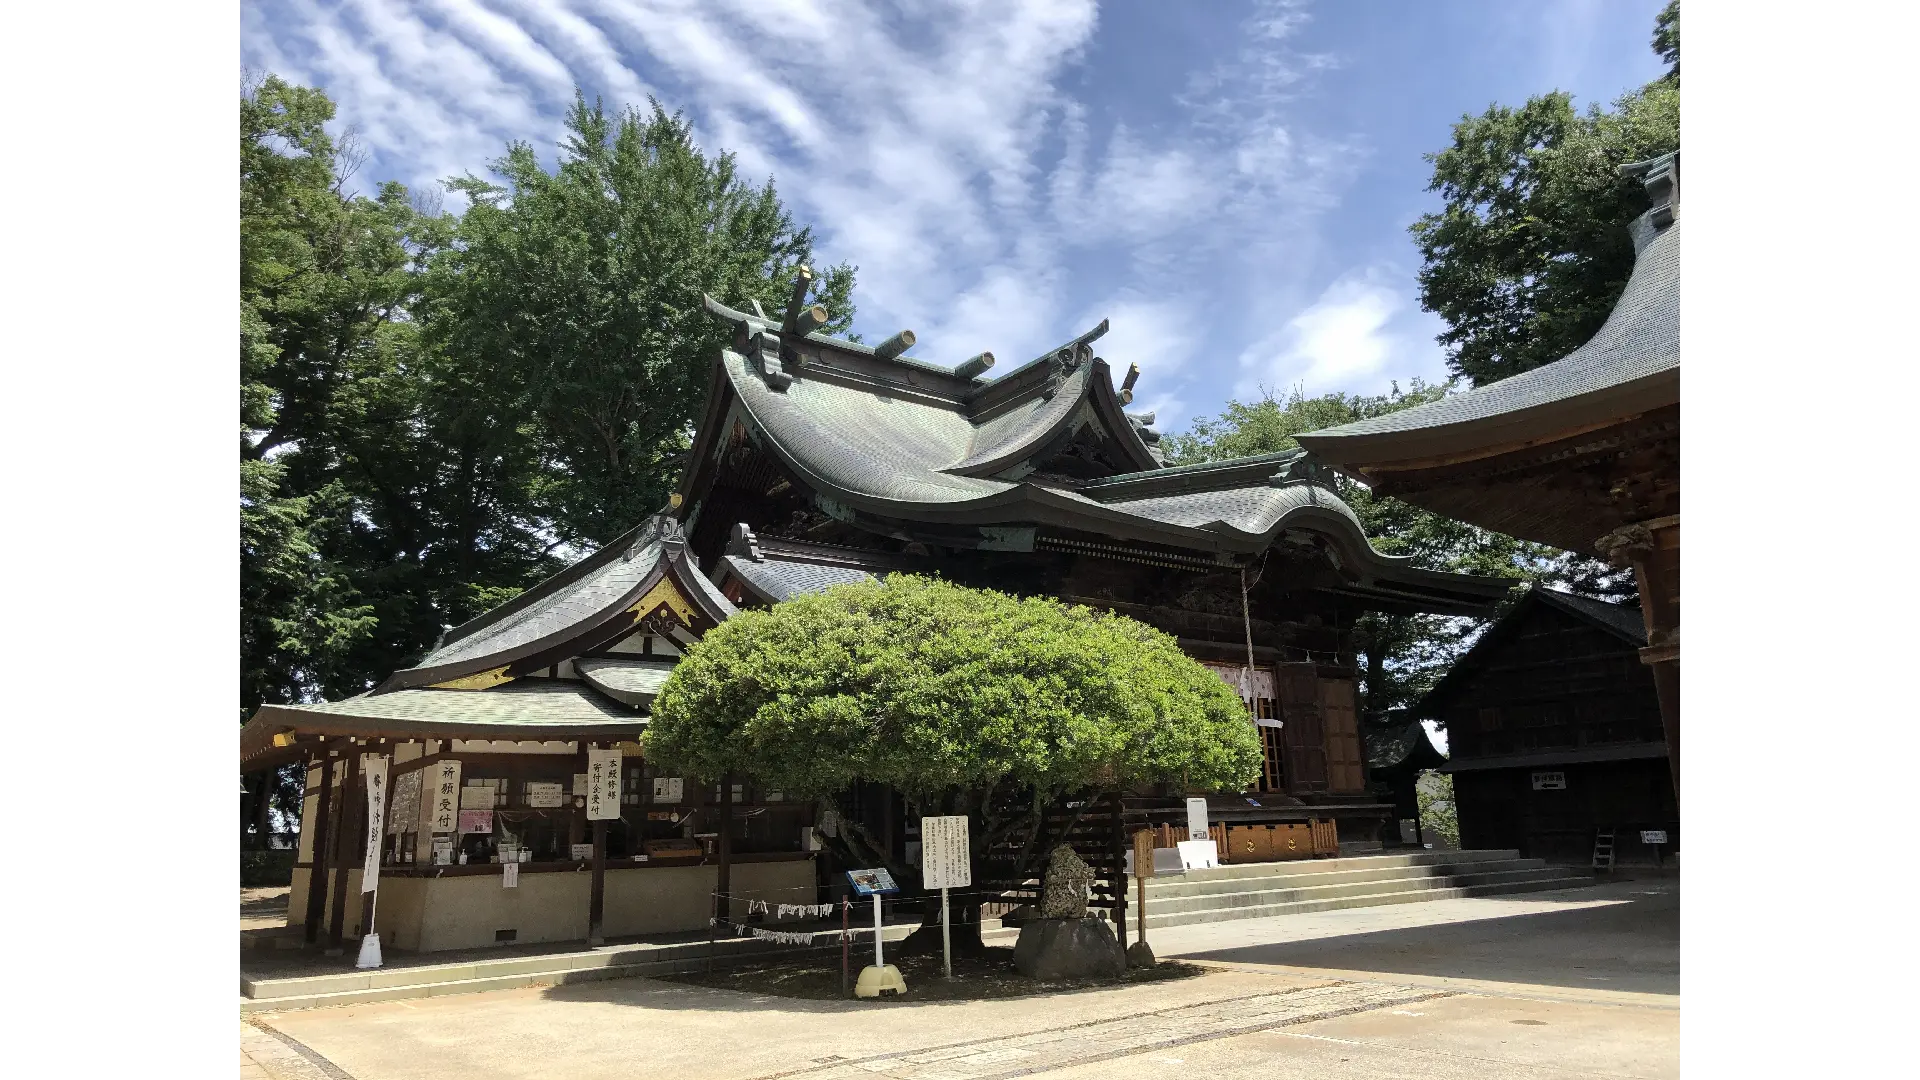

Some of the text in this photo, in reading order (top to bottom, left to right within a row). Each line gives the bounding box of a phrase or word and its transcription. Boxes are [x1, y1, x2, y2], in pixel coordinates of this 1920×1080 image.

[438, 767, 455, 827] 祈願受付
[591, 763, 602, 815] 寄付金受付
